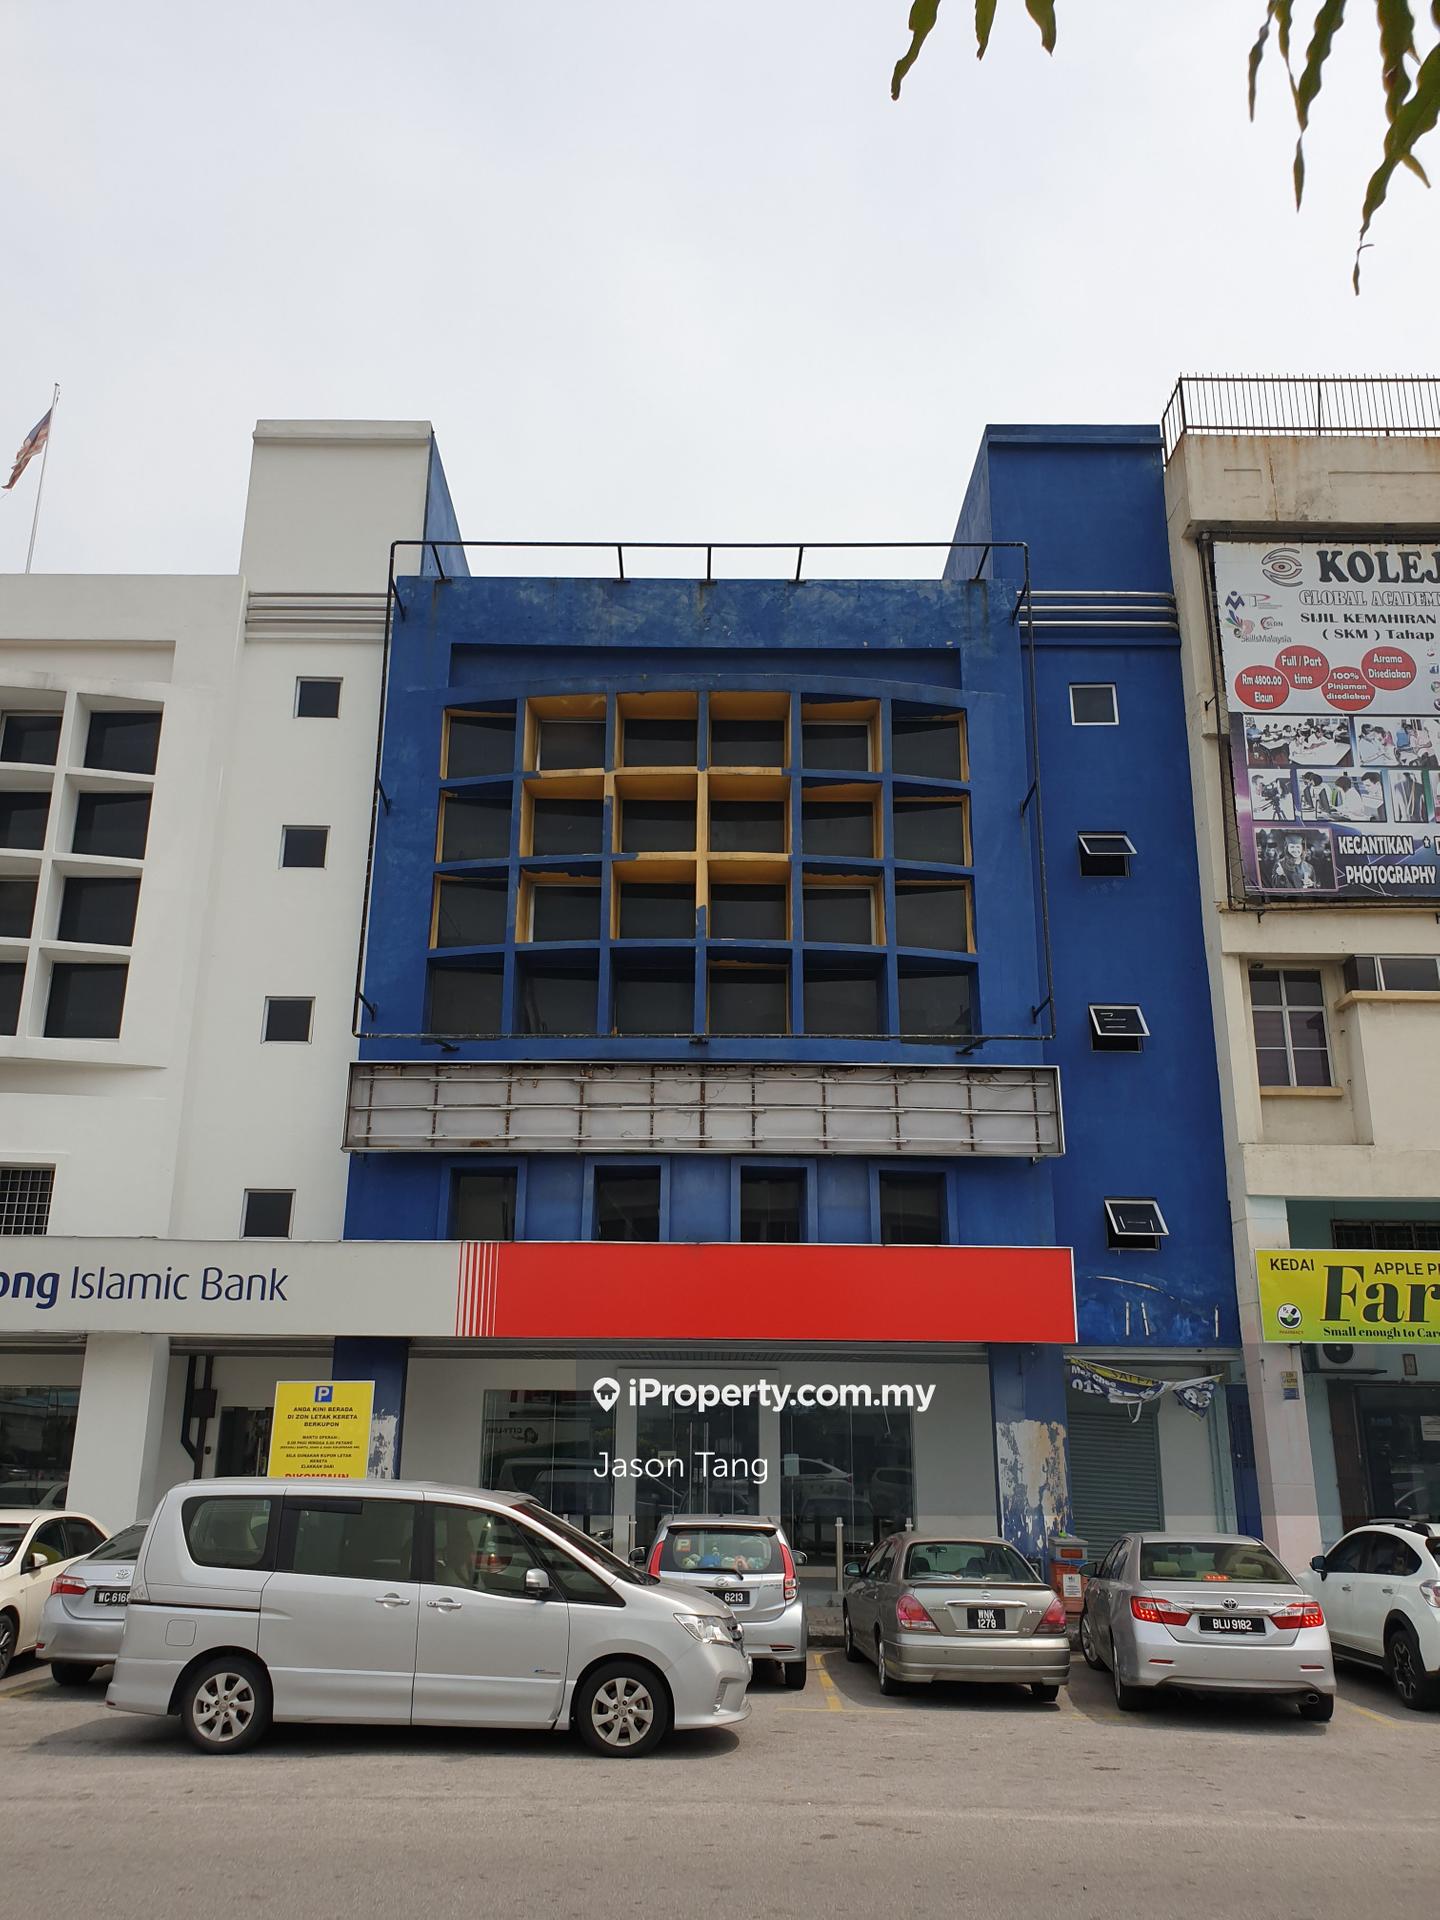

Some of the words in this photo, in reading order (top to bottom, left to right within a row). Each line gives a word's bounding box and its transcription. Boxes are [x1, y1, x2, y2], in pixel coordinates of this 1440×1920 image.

[1316, 550, 1440, 583] KOLEJ
[1299, 590, 1368, 606] GLOBAL
[1300, 613, 1338, 623] SIJIL
[1343, 613, 1436, 624] KEMAHIRAN
[1334, 629, 1369, 639] SKM
[1385, 630, 1435, 642] Tahap
[1281, 655, 1298, 667] Full
[1303, 655, 1322, 667] Part
[1373, 654, 1403, 664] Asrama
[1294, 673, 1313, 684] time
[1332, 672, 1359, 680] 100%
[1368, 669, 1411, 679] Disediakan
[1254, 691, 1274, 703] Elaun
[1337, 835, 1414, 855] KECANTIKAN
[1345, 865, 1436, 884] PHOTOGRAPHY
[1269, 1258, 1315, 1271] KEDAI
[1374, 1262, 1424, 1276] APPLE
[70, 1266, 190, 1301] Islamic
[200, 1267, 289, 1302] Bank
[1323, 1326, 1357, 1337] Small
[1358, 1327, 1400, 1340] enough
[1403, 1328, 1415, 1338] to
[318, 1386, 330, 1402] P
[724, 1592, 744, 1602] 6213
[977, 1609, 995, 1619] WNK
[977, 1618, 997, 1629] 1278
[1212, 1618, 1231, 1629] BLU
[1231, 1619, 1253, 1630] 9182
